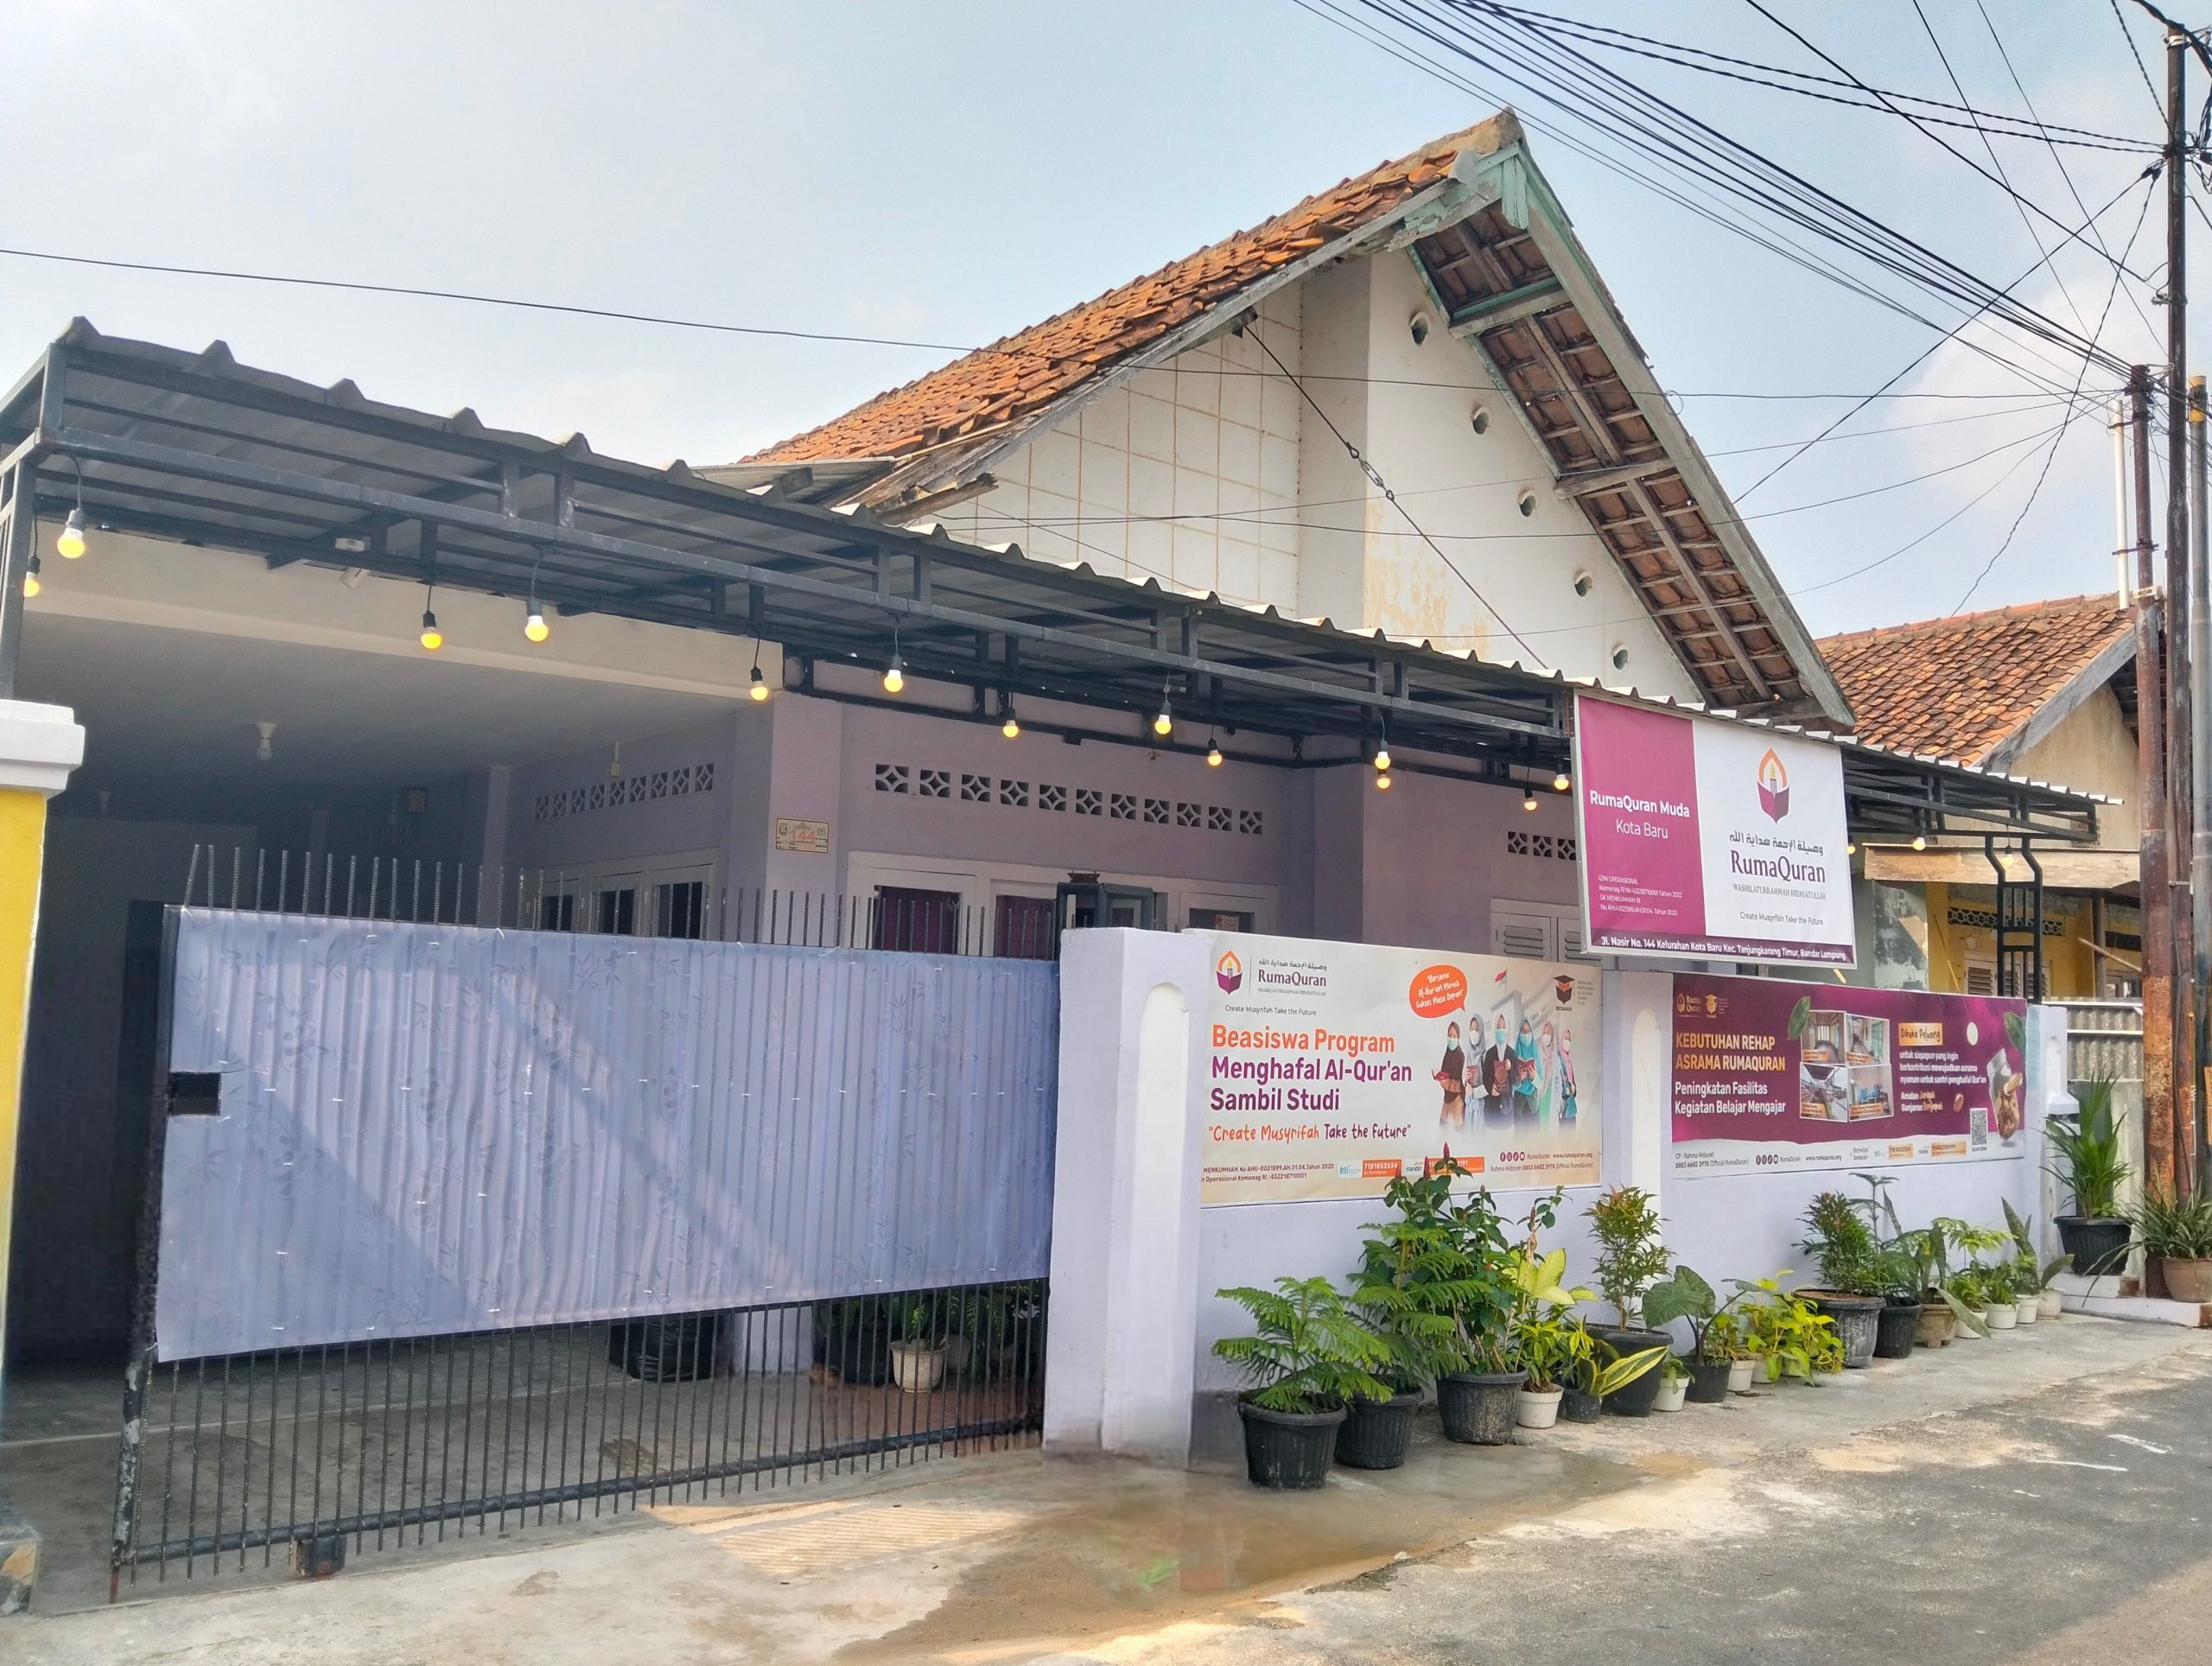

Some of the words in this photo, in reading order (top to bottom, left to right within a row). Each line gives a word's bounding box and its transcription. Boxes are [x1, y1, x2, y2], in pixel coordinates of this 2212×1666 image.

[1590, 790, 1657, 813] RumaQuran
[1660, 800, 1690, 817] Muda
[790, 830, 816, 842] 144
[1616, 819, 1641, 836] Kota
[1643, 823, 1669, 839] Baru
[1729, 830, 1745, 843] الله
[1730, 849, 1826, 883] RumaQuran
[1740, 911, 1758, 920] Create
[1758, 912, 1784, 924] Musyrifah
[1785, 915, 1797, 924] Take
[1797, 916, 1807, 925] the
[1808, 917, 1824, 926] Future
[1601, 937, 1611, 946] Jl.
[1611, 937, 1629, 947] Nasir
[1630, 938, 1643, 948] No.
[1643, 939, 1656, 949] 144
[1656, 940, 1689, 951] Kelurahan
[1690, 943, 1707, 951] Kota
[1707, 944, 1722, 952] Baru
[1723, 944, 1736, 953] Kec.
[1737, 945, 1781, 957] Tanjungkarang
[1781, 948, 1800, 958] Timur,
[1800, 950, 1820, 958] Bandar
[1821, 951, 1846, 961] Lampung
[1257, 969, 1327, 987] RumaQuran
[1245, 1006, 1273, 1014] Musyrifah
[1211, 1024, 1309, 1050] Beasiswa
[1314, 1028, 1395, 1058] Program
[1675, 1033, 1740, 1049] KEBUTUHAN
[1741, 1034, 1776, 1051] REHAP
[1901, 1028, 1918, 1039] Dibuka
[1919, 1028, 1941, 1042] Peluang
[1675, 1054, 1721, 1070] ASRAMA
[1722, 1055, 1786, 1071] RUMAQURAN
[1936, 1052, 1947, 1062] yang
[1947, 1052, 1959, 1062] ingin
[1211, 1056, 1320, 1085] Menghafal
[1325, 1059, 1413, 1082] Al-Qur'an
[1899, 1063, 1930, 1071] berkontribusi
[1900, 1077, 1920, 1085] nyaman
[1920, 1075, 1934, 1084] untuk
[1675, 1081, 1731, 1098] Peningkatan
[1732, 1081, 1768, 1095] Fasilitas
[1210, 1087, 1281, 1110] Sambil
[1286, 1088, 1340, 1110] Studi
[1675, 1100, 1715, 1117] Kegiatan
[1716, 1100, 1747, 1116] Belajar
[1747, 1099, 1786, 1116] Mengajar
[1209, 1124, 1256, 1141] "Create
[1261, 1124, 1319, 1144] Musyrifah
[1324, 1123, 1347, 1139] Take
[1351, 1124, 1368, 1139] the
[1205, 1175, 1237, 1184] Operasional
[1237, 1173, 1262, 1182] Kemenag
